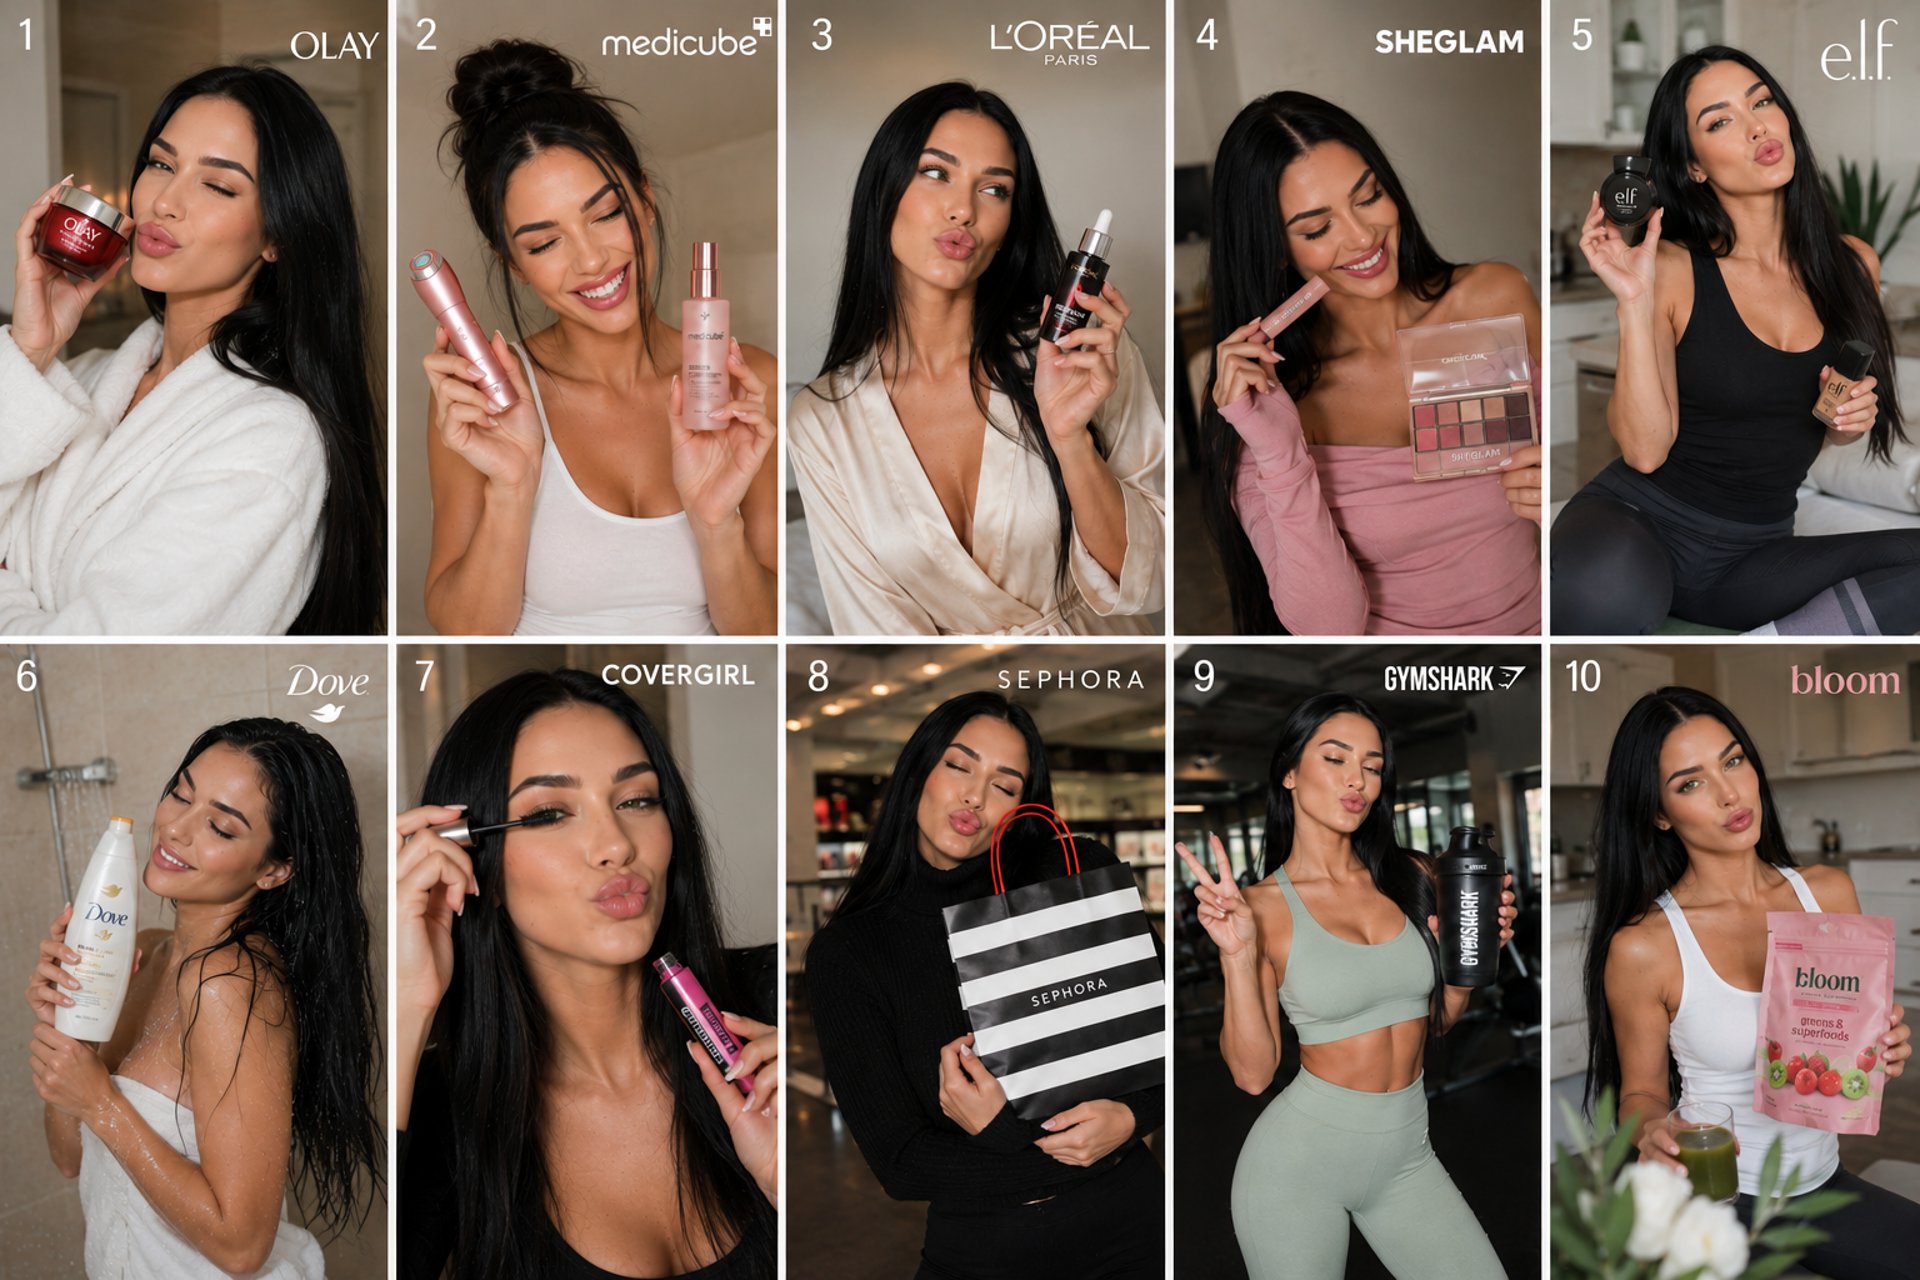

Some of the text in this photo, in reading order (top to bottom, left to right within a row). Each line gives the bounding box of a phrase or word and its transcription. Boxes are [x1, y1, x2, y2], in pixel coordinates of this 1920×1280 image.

[64, 217, 102, 242] OLAY
[85, 902, 129, 926] Dove
[1030, 977, 1108, 1007] SEPHORA
[1795, 967, 1860, 993] bloom
[1791, 1027, 1850, 1042] superfoods
